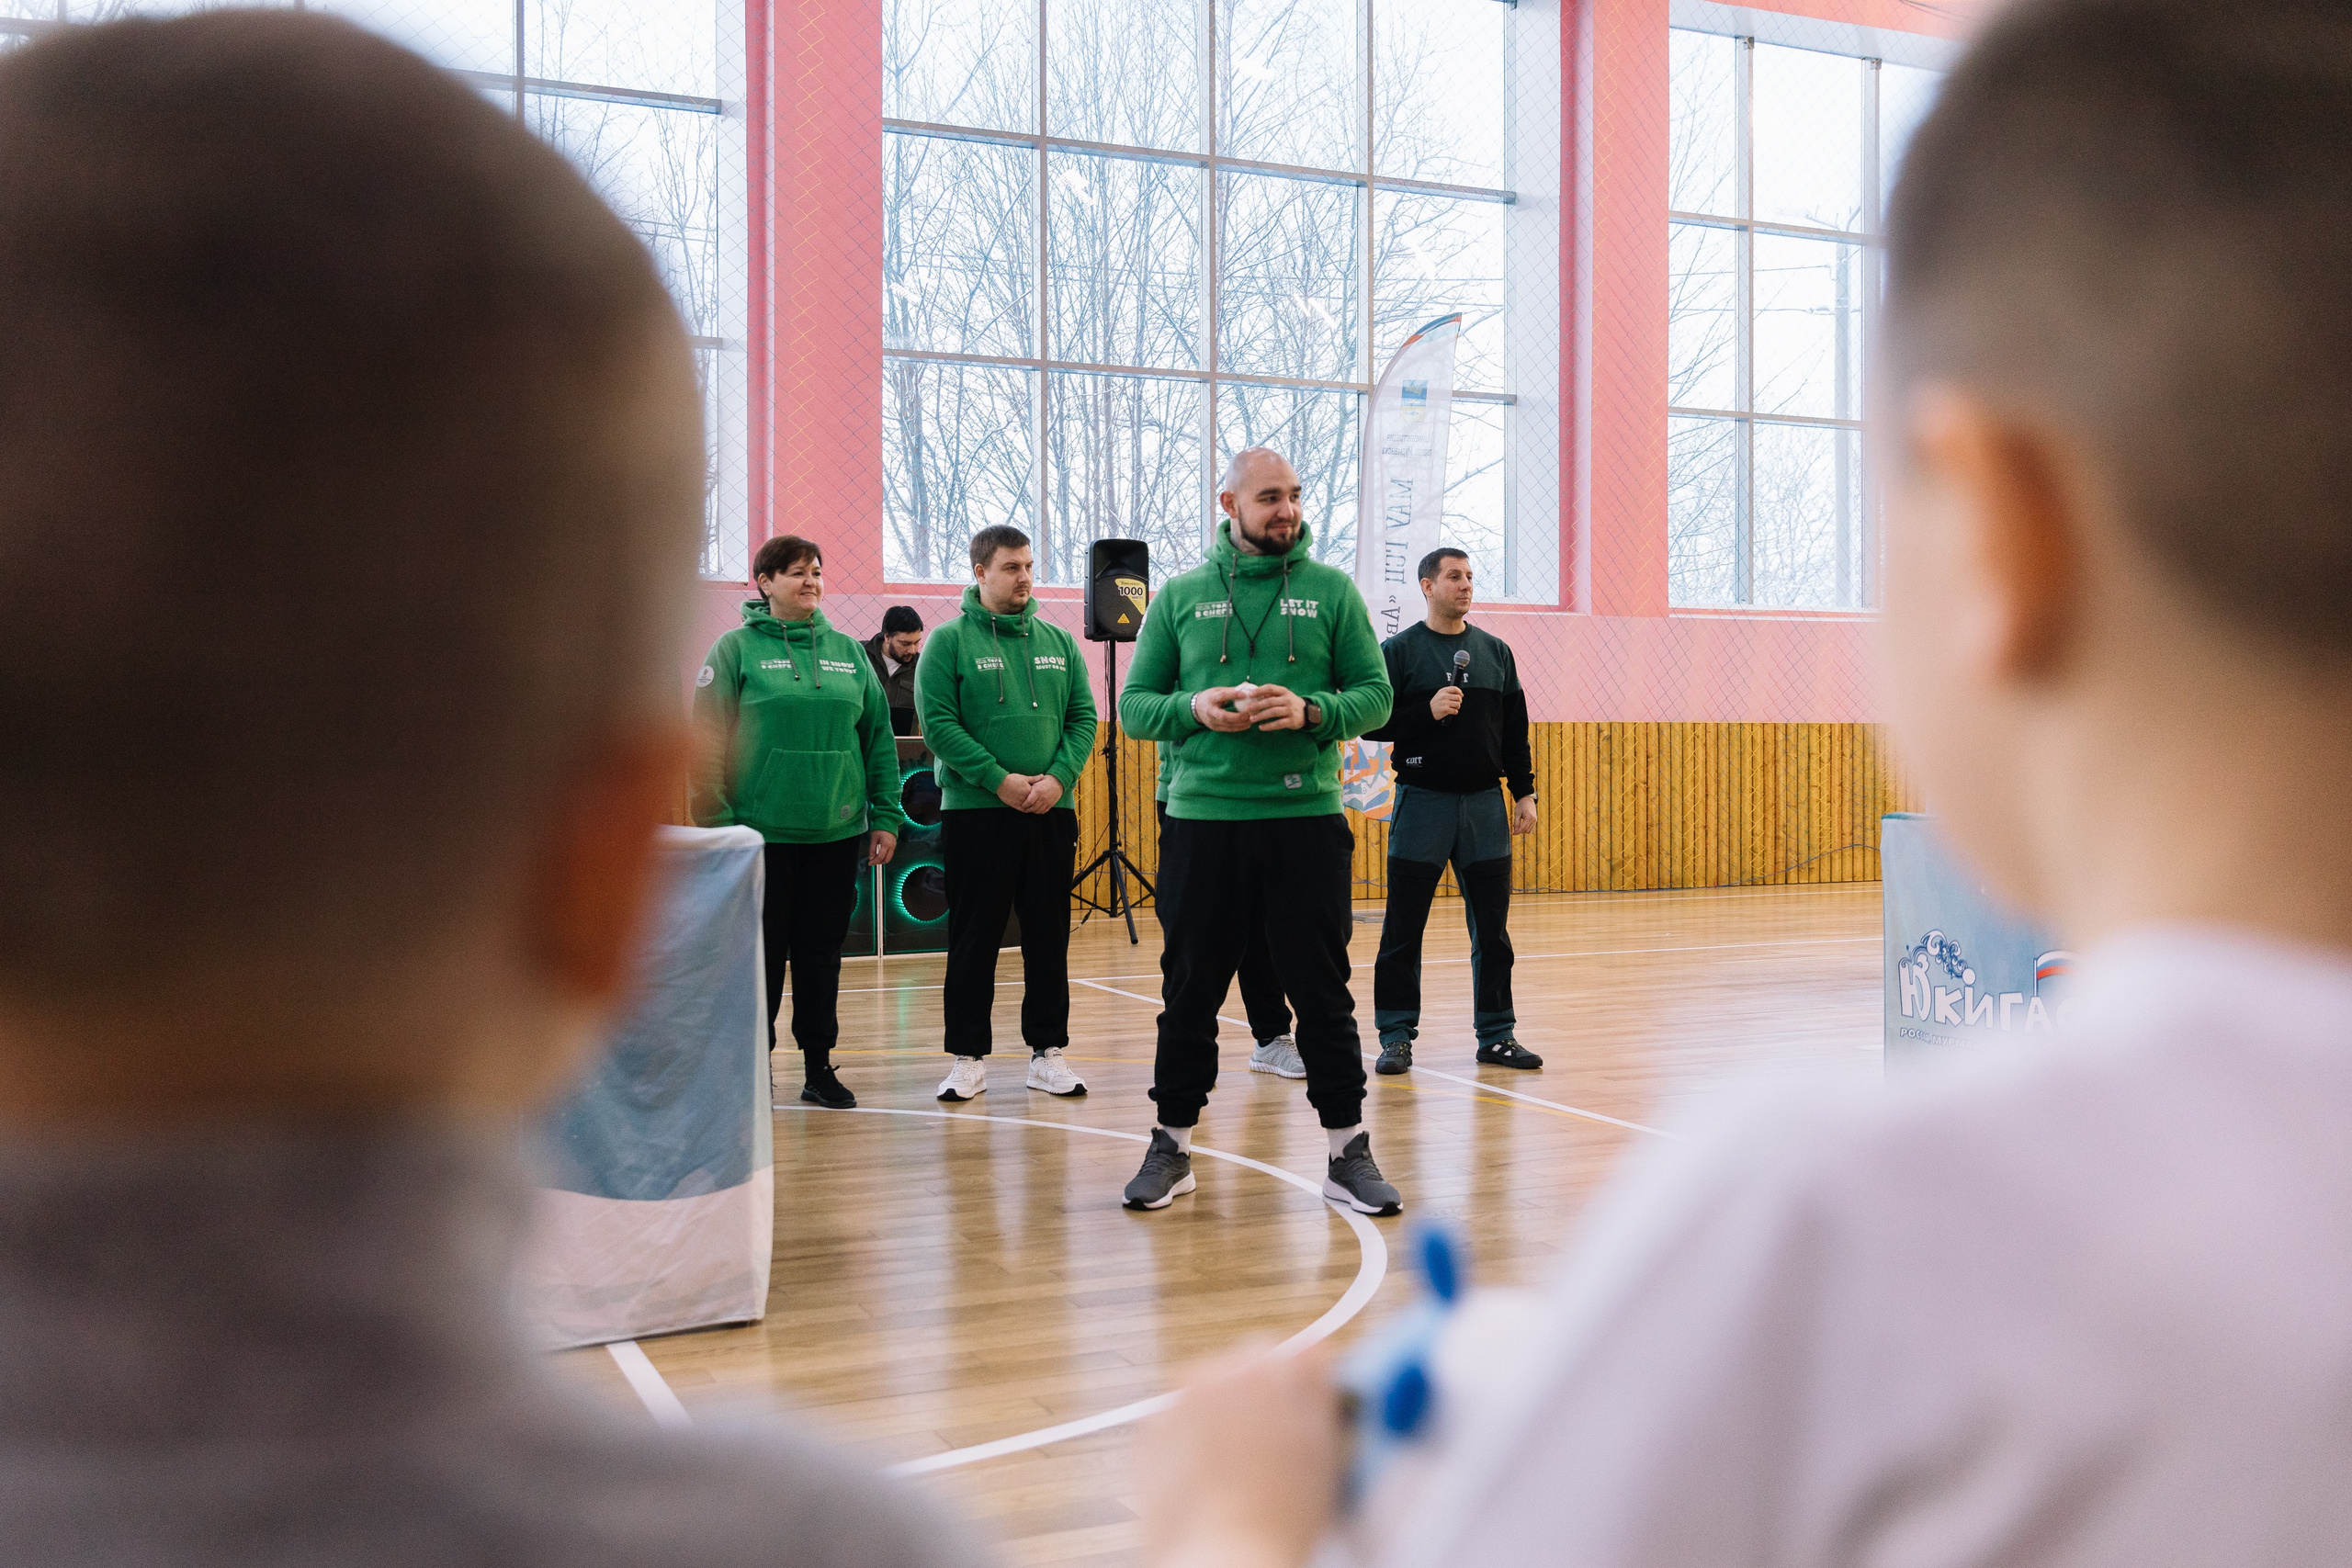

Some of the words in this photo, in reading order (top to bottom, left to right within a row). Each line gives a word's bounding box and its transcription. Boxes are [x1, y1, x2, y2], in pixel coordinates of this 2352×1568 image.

[1118, 586, 1144, 596] 1000
[1280, 598, 1304, 607] LET
[1306, 599, 1319, 609] IT
[1280, 607, 1317, 618] SNOW
[1034, 656, 1066, 666] SNOW
